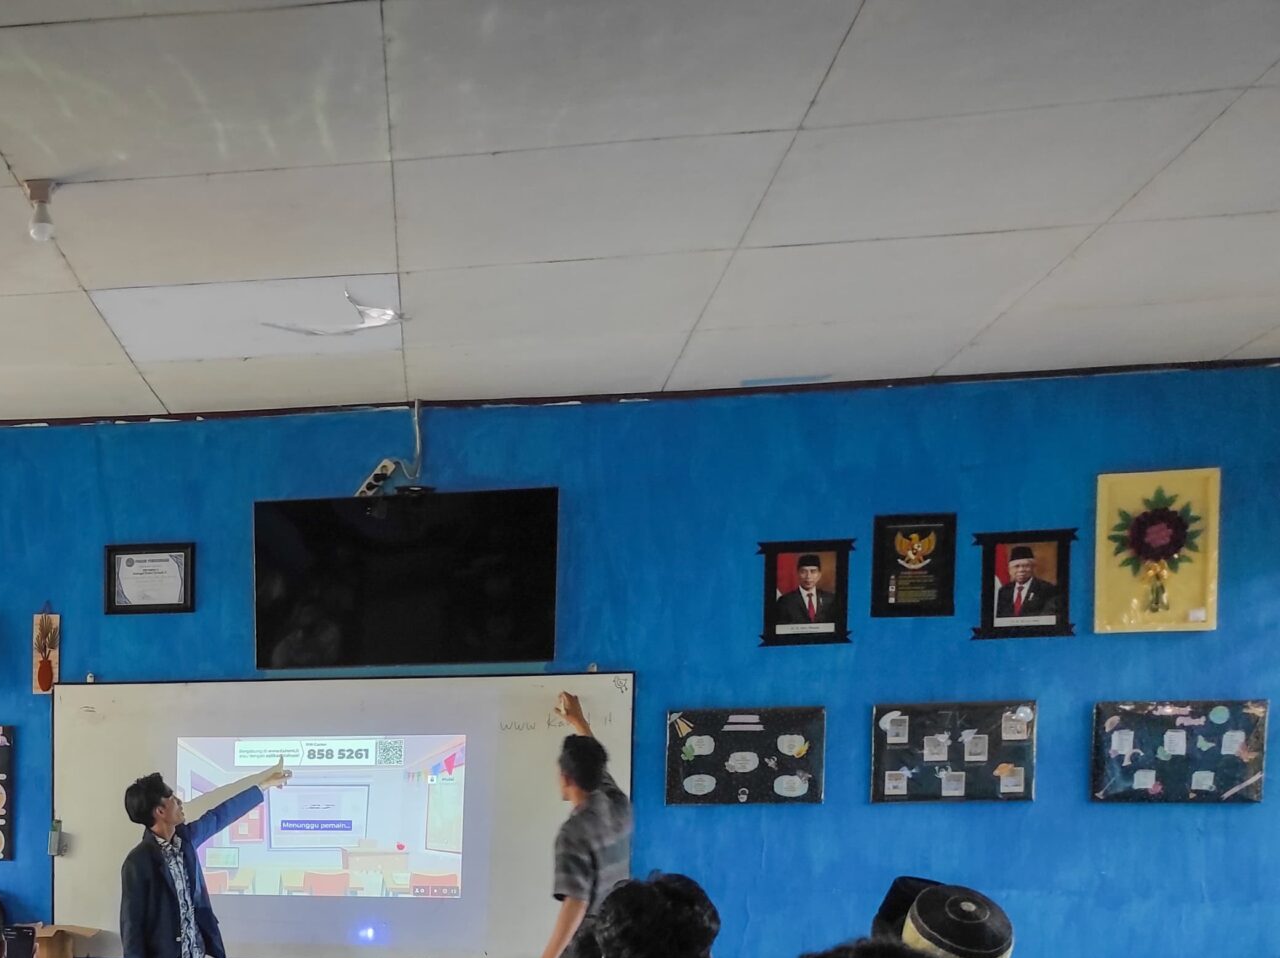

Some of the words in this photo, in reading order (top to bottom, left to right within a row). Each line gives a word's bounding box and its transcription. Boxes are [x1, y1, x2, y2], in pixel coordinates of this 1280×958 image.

[307, 748, 334, 760] 858
[337, 748, 369, 760] 5261
[282, 821, 319, 830] Menunggu
